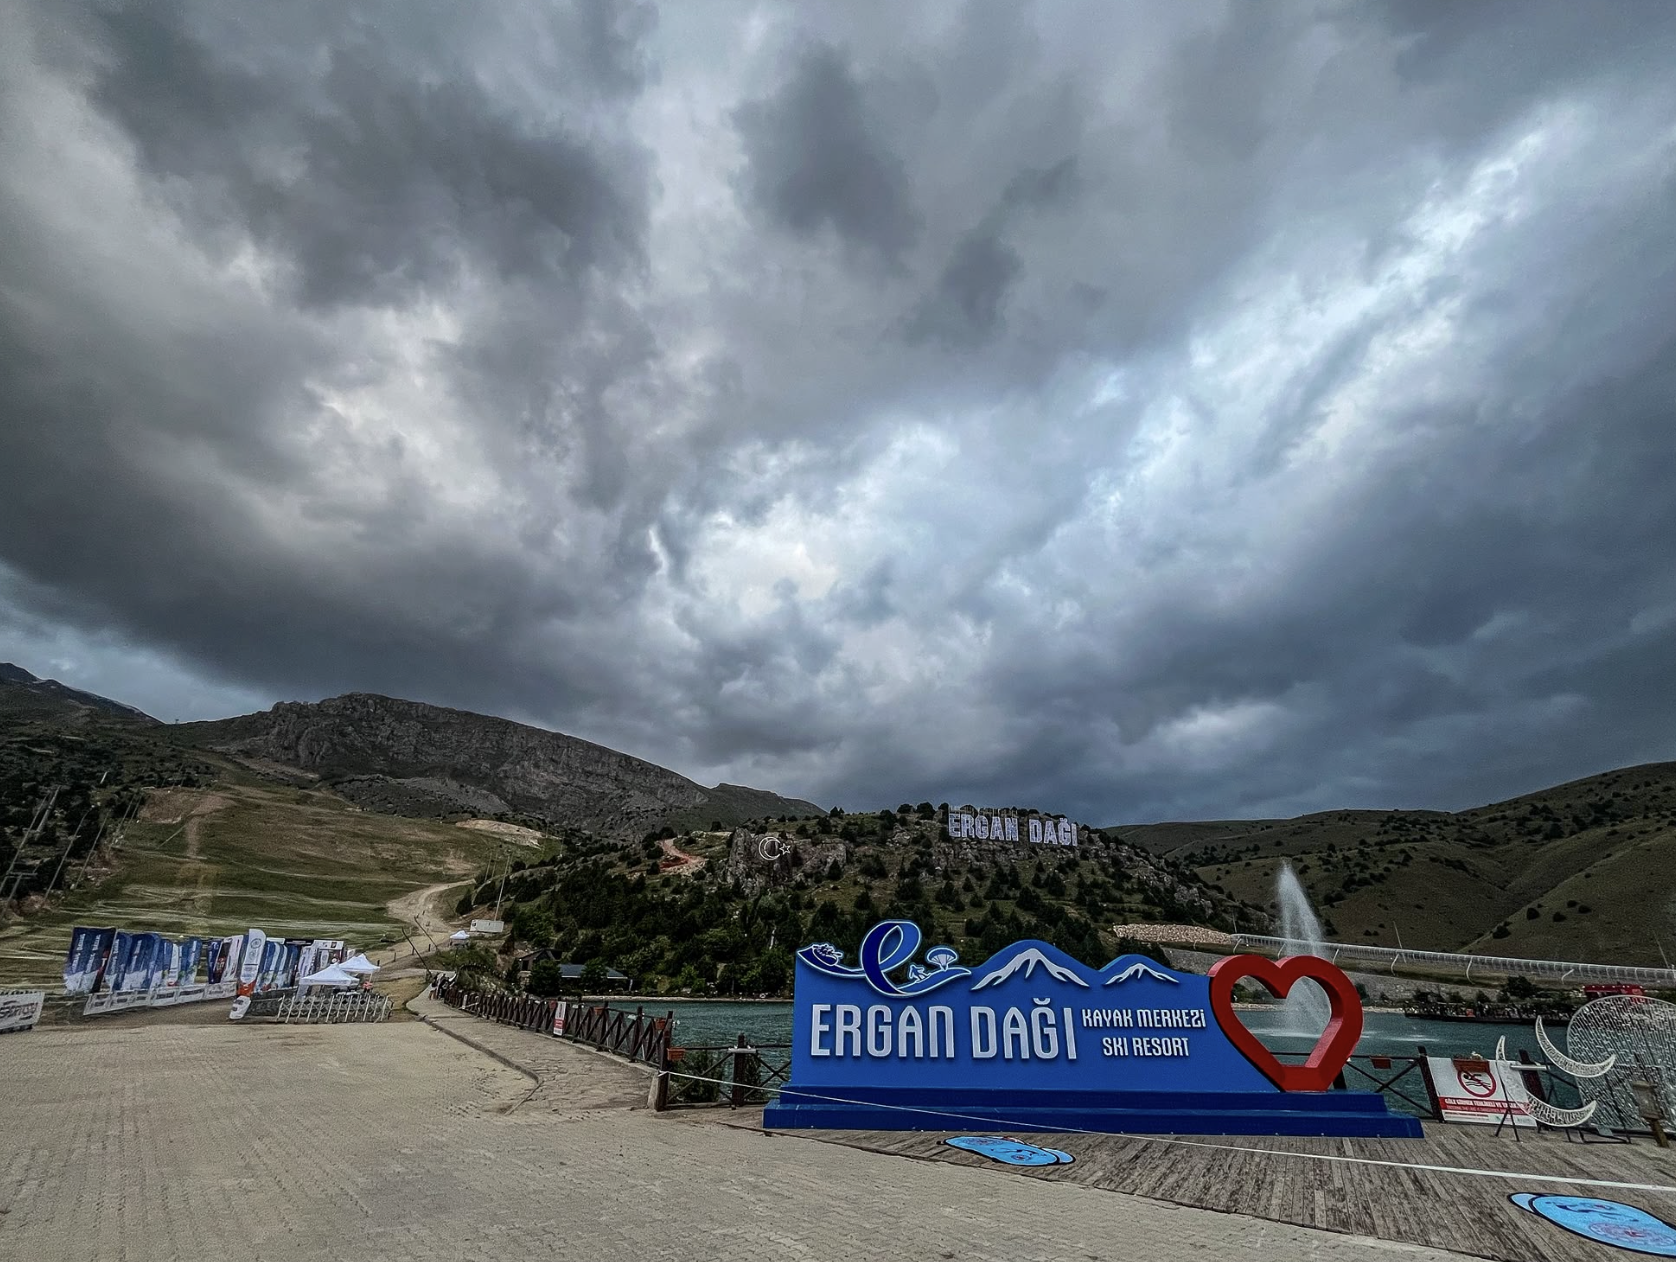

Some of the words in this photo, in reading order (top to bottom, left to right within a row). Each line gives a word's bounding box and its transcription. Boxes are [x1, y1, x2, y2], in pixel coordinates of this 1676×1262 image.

[949, 813, 1019, 842] ERGAN
[1028, 817, 1078, 847] DAĞI
[811, 1004, 955, 1058] ERGAN
[970, 998, 1077, 1060] DAĞI
[1081, 1008, 1134, 1027] KAYAK
[1136, 1008, 1207, 1028] MERKEZİ
[1102, 1037, 1129, 1056] SKI
[1132, 1037, 1189, 1057] RESORT
